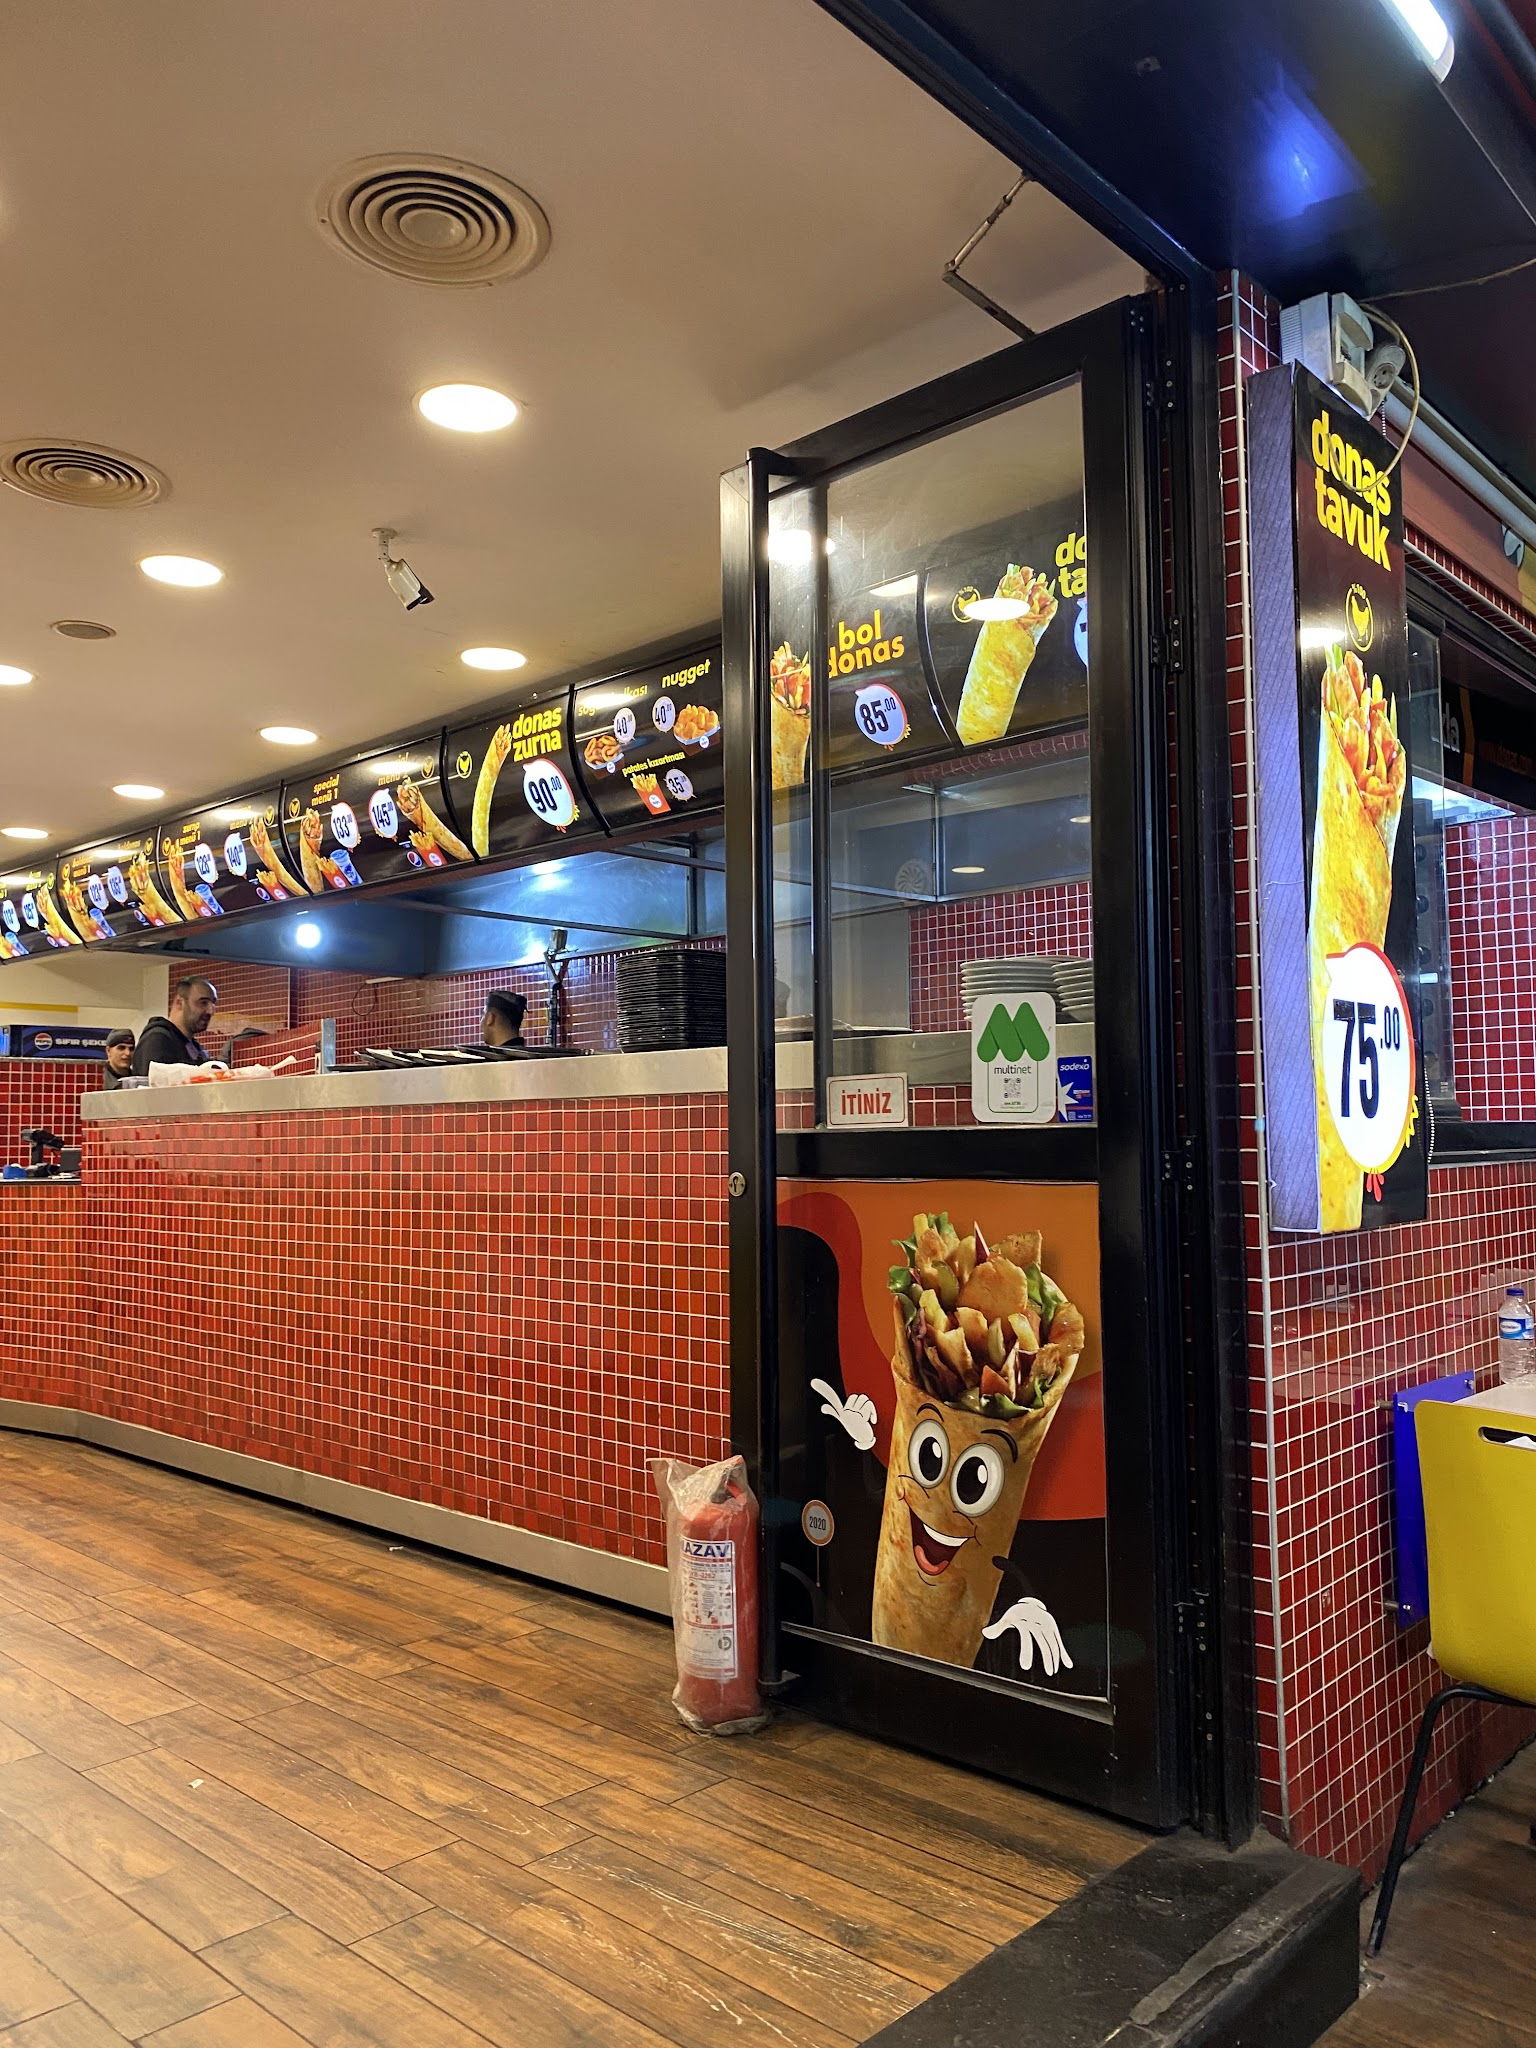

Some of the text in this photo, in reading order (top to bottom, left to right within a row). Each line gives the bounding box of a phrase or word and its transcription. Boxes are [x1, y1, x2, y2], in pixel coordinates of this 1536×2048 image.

[1311, 410, 1392, 515] donas
[1314, 467, 1392, 572] tavuk
[838, 609, 881, 650] bol
[661, 659, 711, 688] nugget
[512, 707, 562, 741] donas
[859, 696, 897, 735] 85.00
[513, 730, 562, 763] zurna
[313, 774, 340, 795] special
[622, 763, 648, 777] patates
[311, 788, 339, 806] menü 1
[528, 775, 563, 813] 90.00
[82, 1038, 107, 1047] ŞEKE
[993, 1064, 1032, 1075] multinet
[1060, 1062, 1090, 1071] sodexo
[1333, 998, 1400, 1119] 75.00
[841, 1088, 892, 1116] İTİNİZ
[809, 1515, 827, 1532] 2020
